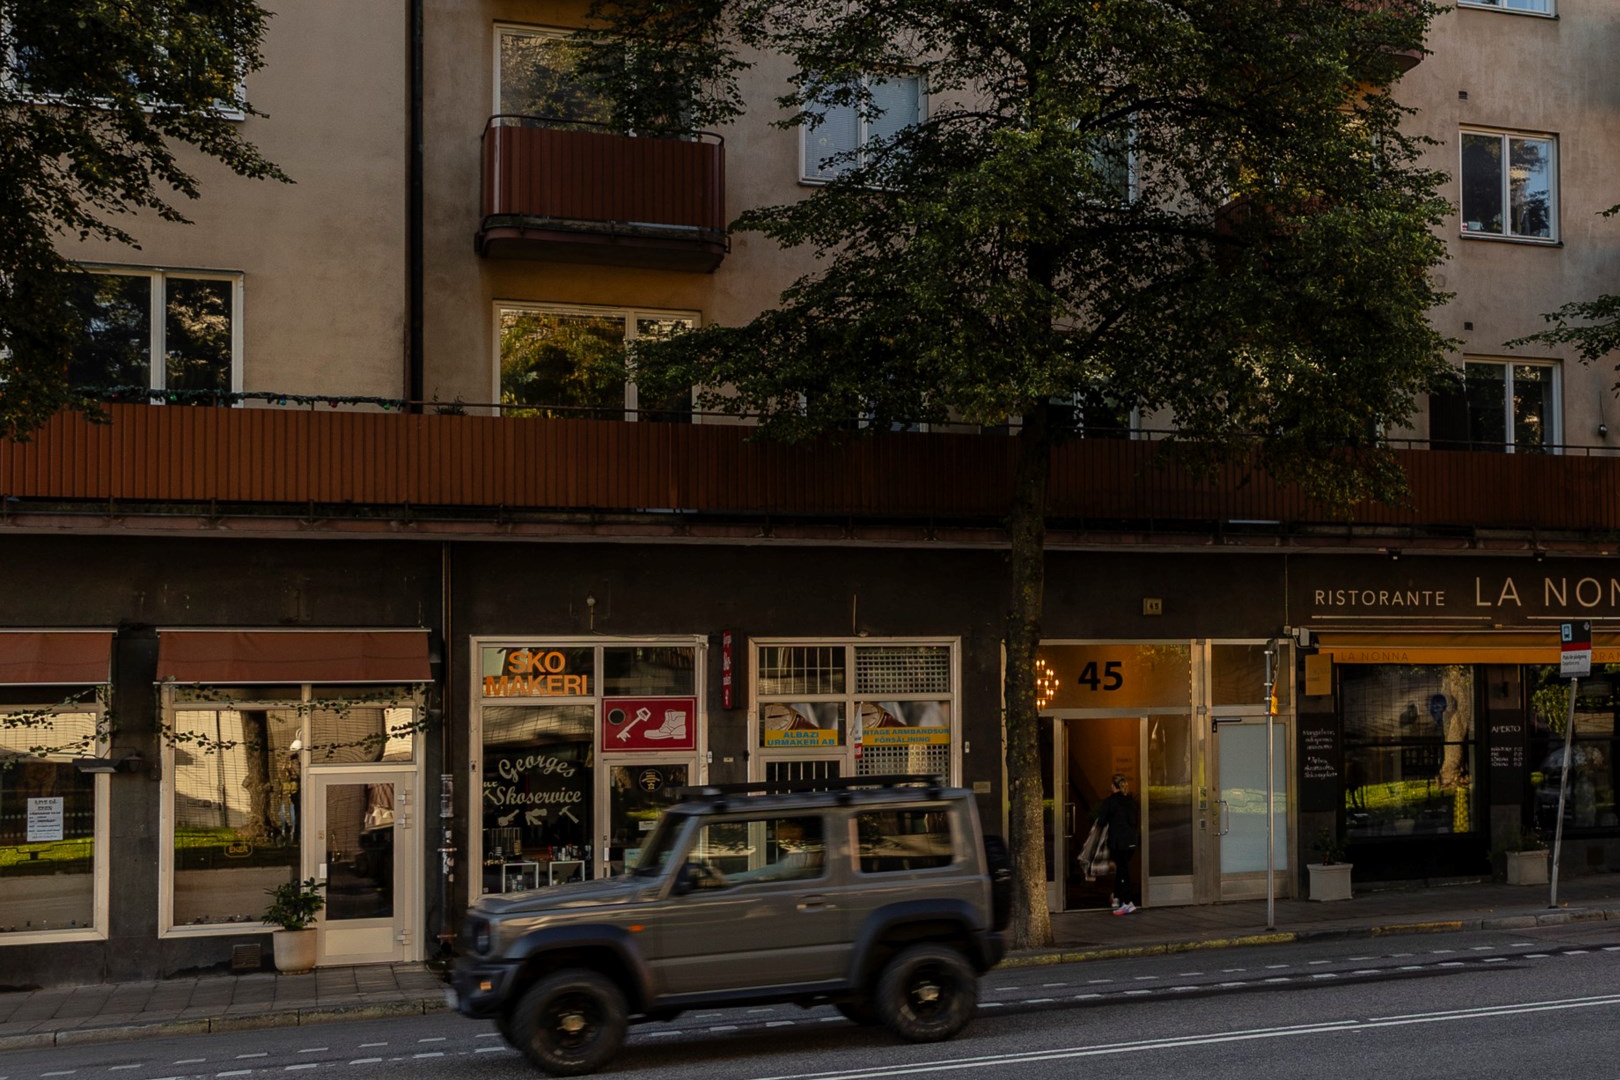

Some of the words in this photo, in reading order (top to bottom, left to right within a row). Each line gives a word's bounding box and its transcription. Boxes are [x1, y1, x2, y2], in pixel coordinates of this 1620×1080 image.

[1315, 589, 1446, 606] RISTORANTE
[1475, 576, 1522, 607] LA
[1149, 602, 1159, 610] 45
[508, 651, 566, 673] SKO
[1360, 652, 1409, 662] NONNA
[485, 674, 588, 696] MAKERI
[1078, 661, 1123, 691] 45
[783, 731, 820, 739] ALBAZI
[498, 755, 576, 783] Georges
[495, 785, 583, 806] Skoservice
